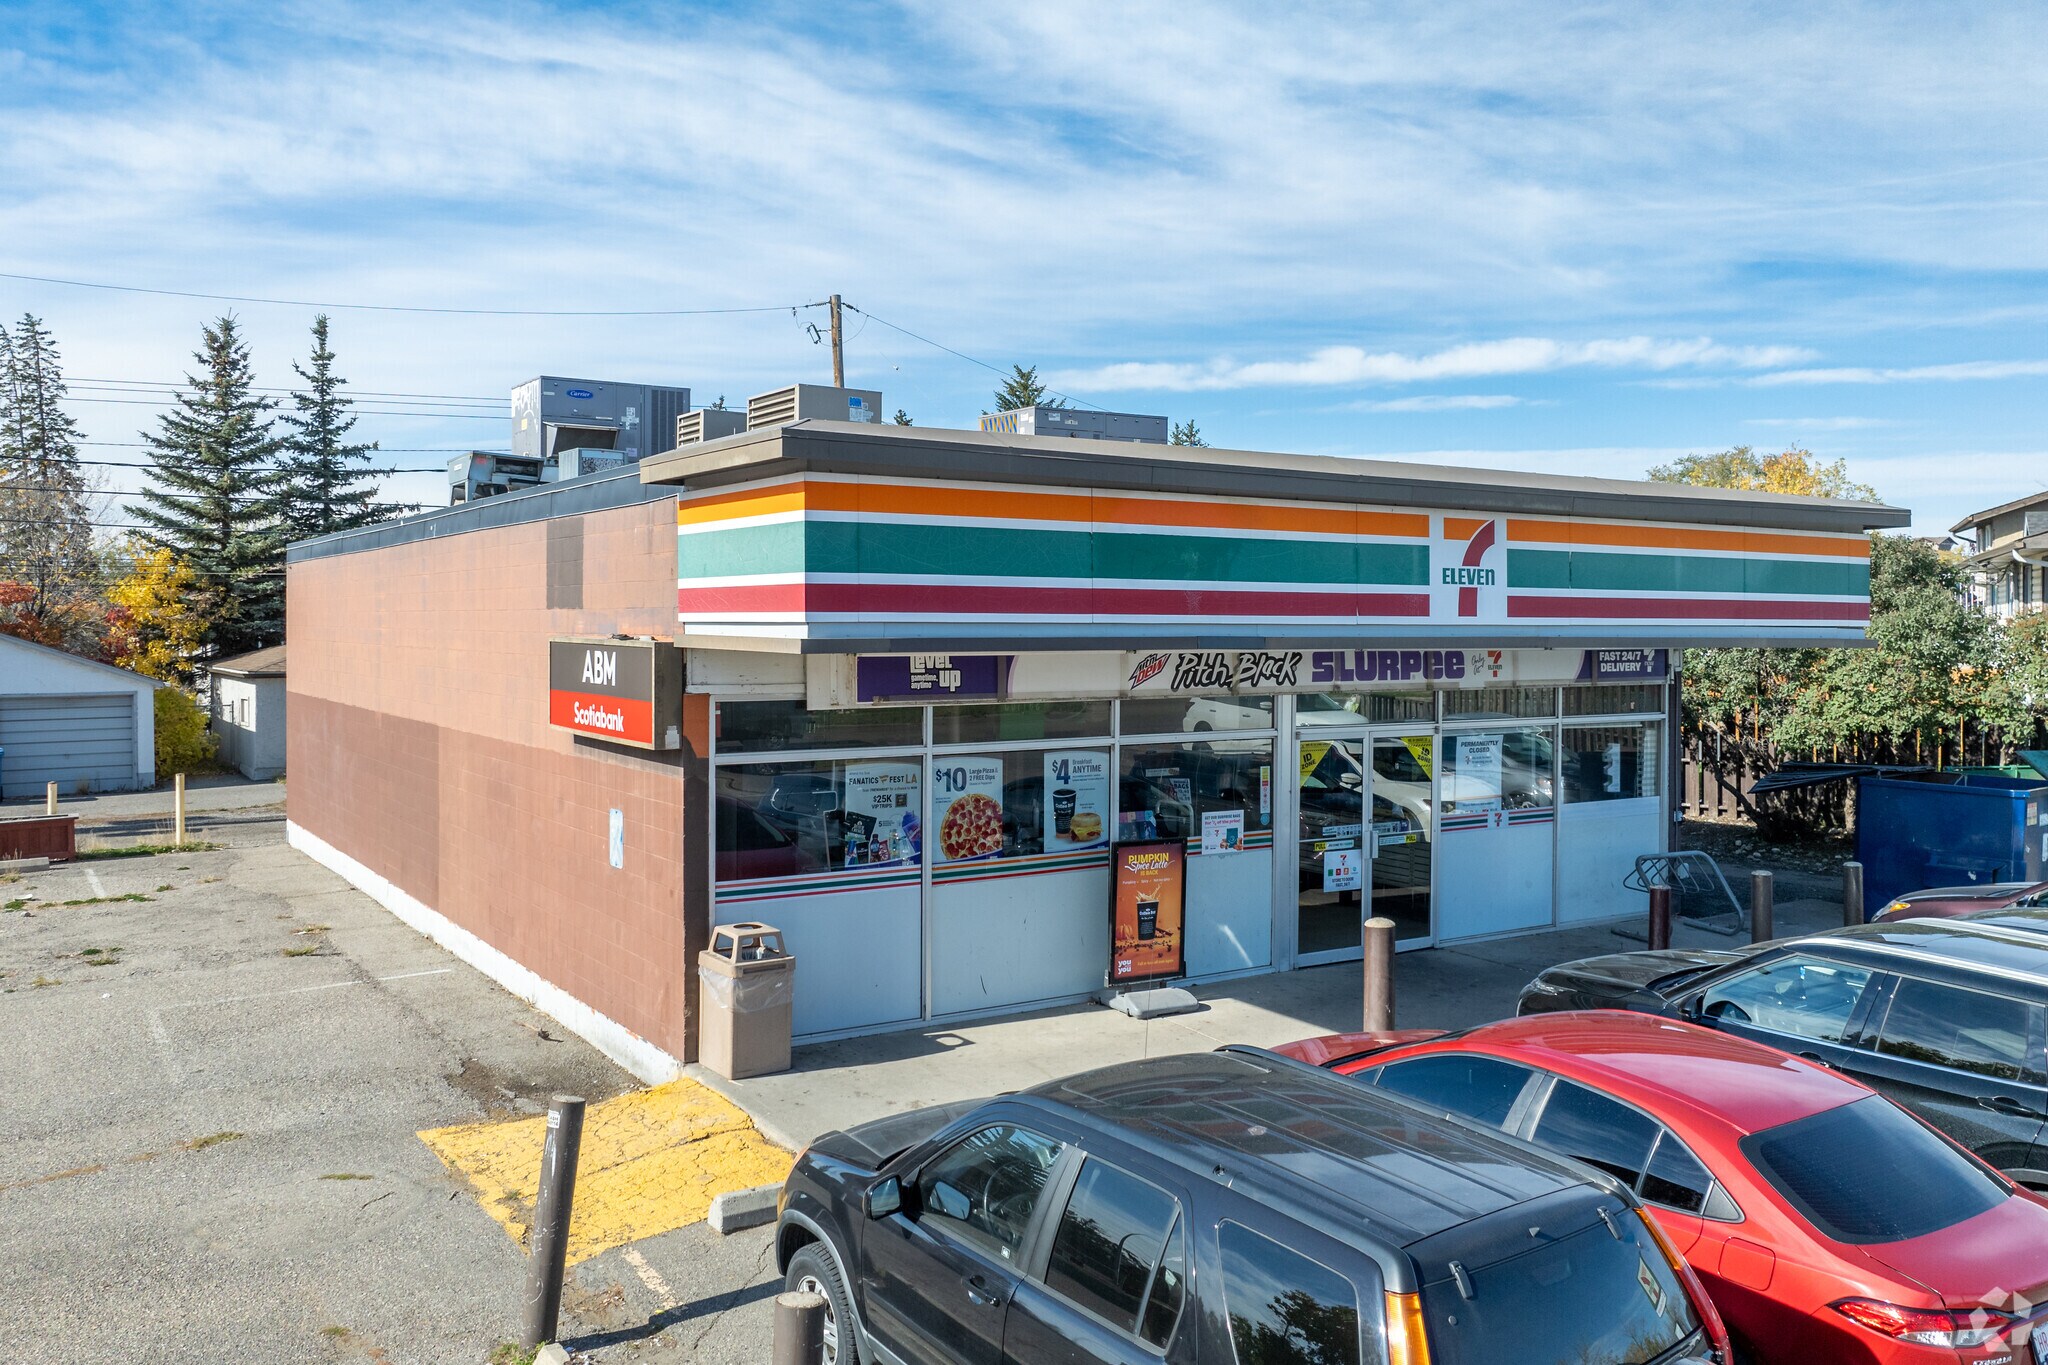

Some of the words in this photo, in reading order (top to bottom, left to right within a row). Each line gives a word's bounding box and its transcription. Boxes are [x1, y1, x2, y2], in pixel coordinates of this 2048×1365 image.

[1600, 651, 1621, 661] FAST
[1621, 651, 1641, 661] 24/7
[582, 650, 616, 686] ABM
[1172, 653, 1231, 691] Pitch
[1600, 662, 1641, 672] DELIVERY
[573, 701, 624, 732] Scotiabank
[1072, 758, 1092, 766] Breakfast
[1303, 752, 1312, 763] ID
[1072, 765, 1102, 774] ANYTIME
[1300, 759, 1316, 770] ZONE
[1052, 758, 1071, 785] $4
[849, 776, 880, 785] FANATICS
[889, 775, 905, 783] FEST
[905, 773, 917, 783] LA
[935, 767, 967, 792] $10
[873, 794, 892, 803] $25K
[1128, 853, 1169, 864] PUMPKIN
[1124, 861, 1150, 874] Spice
[1150, 860, 1175, 870] Latte
[1118, 959, 1132, 967] you
[1118, 967, 1132, 975] you
